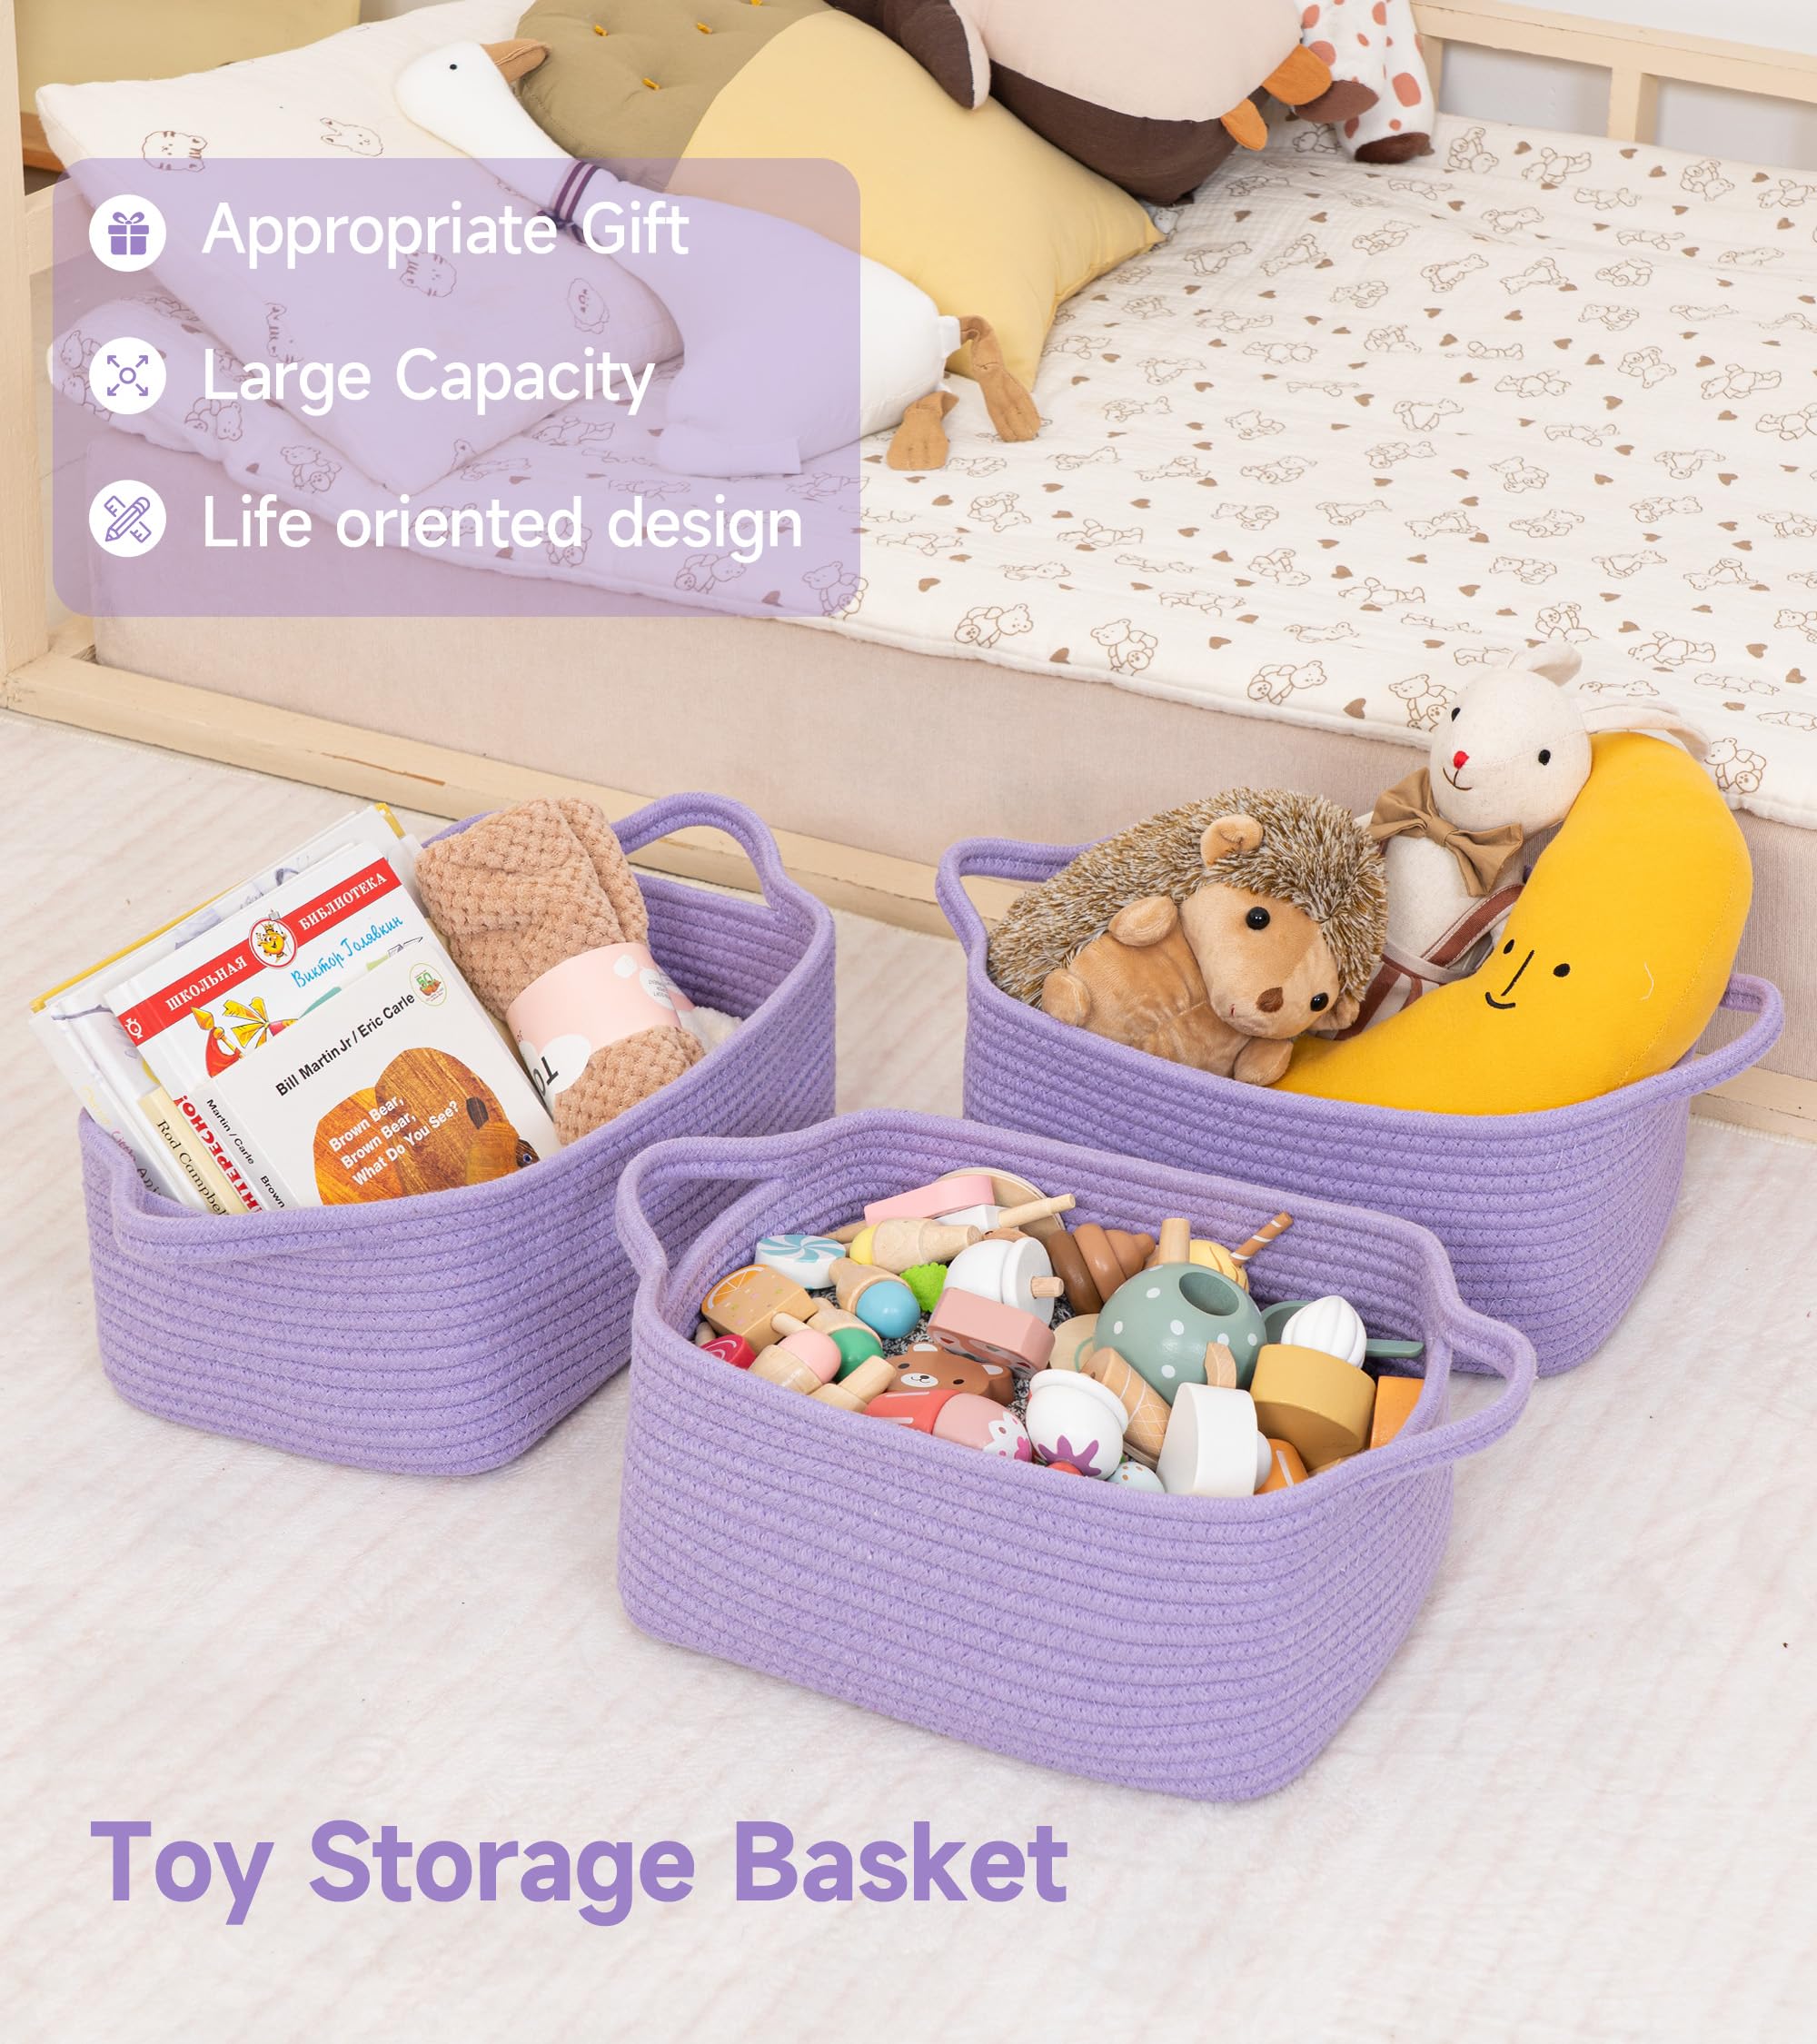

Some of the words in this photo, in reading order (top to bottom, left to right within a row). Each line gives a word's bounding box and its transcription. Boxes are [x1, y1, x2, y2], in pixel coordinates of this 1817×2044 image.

[165, 956, 248, 1011] ШКОЛЬНАЯ
[298, 873, 388, 930] БИБЛИОТЕКА
[291, 951, 344, 988] Виктор
[340, 916, 403, 957] Голявкин
[275, 1074, 300, 1096] Bill
[298, 1047, 341, 1080] Martin
[339, 1037, 352, 1052] Jr
[352, 1030, 359, 1044] /
[357, 1016, 383, 1038] Eric
[382, 993, 415, 1019] Carle
[155, 1118, 182, 1150] Rod
[179, 1151, 229, 1215] Campbel
[173, 1095, 263, 1214] НТЕРЕСНО!
[206, 1099, 232, 1133] Martin
[233, 1137, 254, 1166] Carle
[260, 1176, 285, 1208] Brown
[328, 1117, 371, 1153] Brown
[368, 1096, 405, 1123] Bear,
[340, 1135, 382, 1170] Brown
[380, 1112, 417, 1140] Bear,
[352, 1156, 388, 1186] What
[385, 1143, 406, 1163] Do
[403, 1126, 431, 1147] You
[428, 1100, 460, 1130] See?
